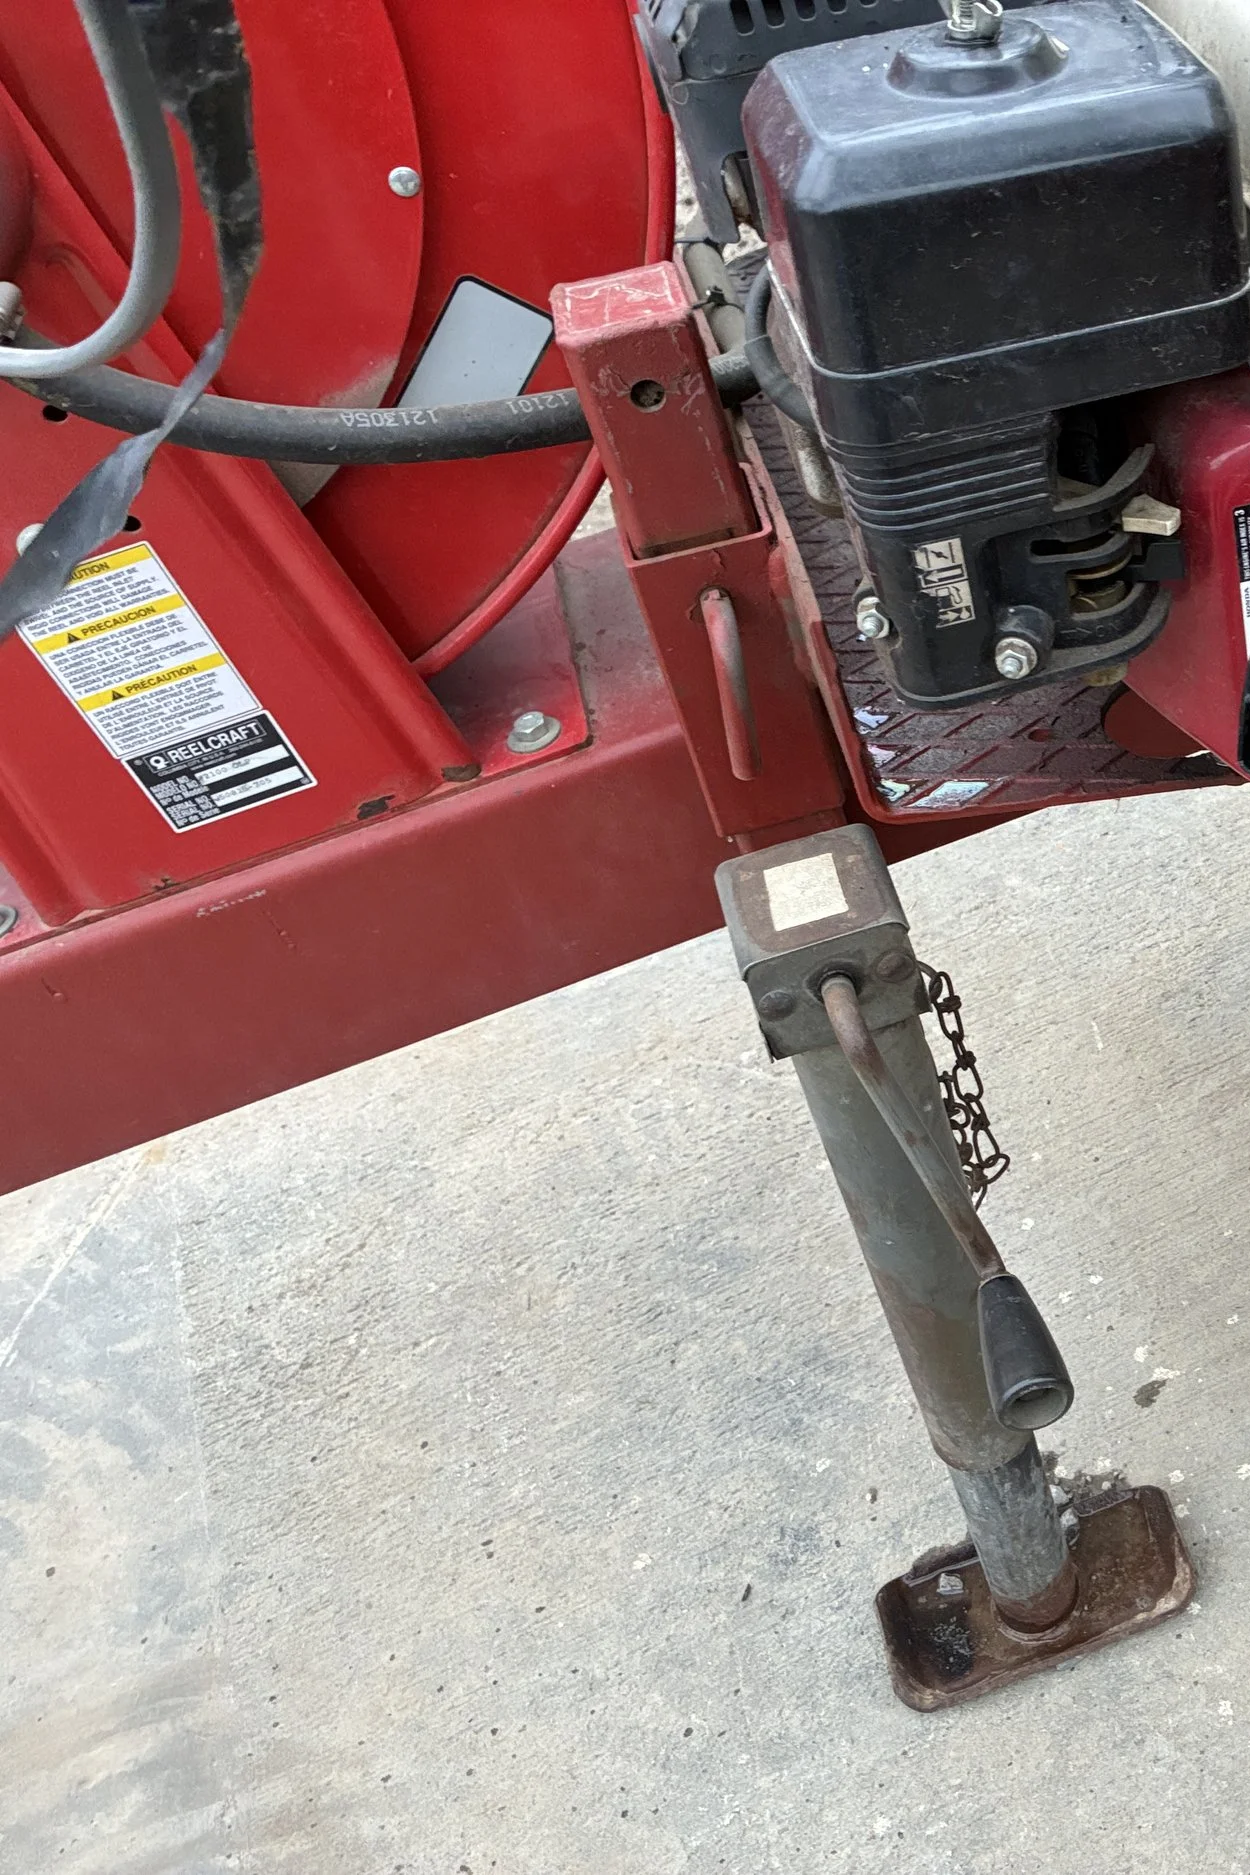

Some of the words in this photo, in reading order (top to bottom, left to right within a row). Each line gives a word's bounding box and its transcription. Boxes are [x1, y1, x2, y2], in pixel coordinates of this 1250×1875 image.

[506, 392, 571, 415] 12101
[341, 408, 438, 428] 121305A
[79, 605, 156, 636] PRECAUCION
[166, 721, 263, 764] REELCRAFT
